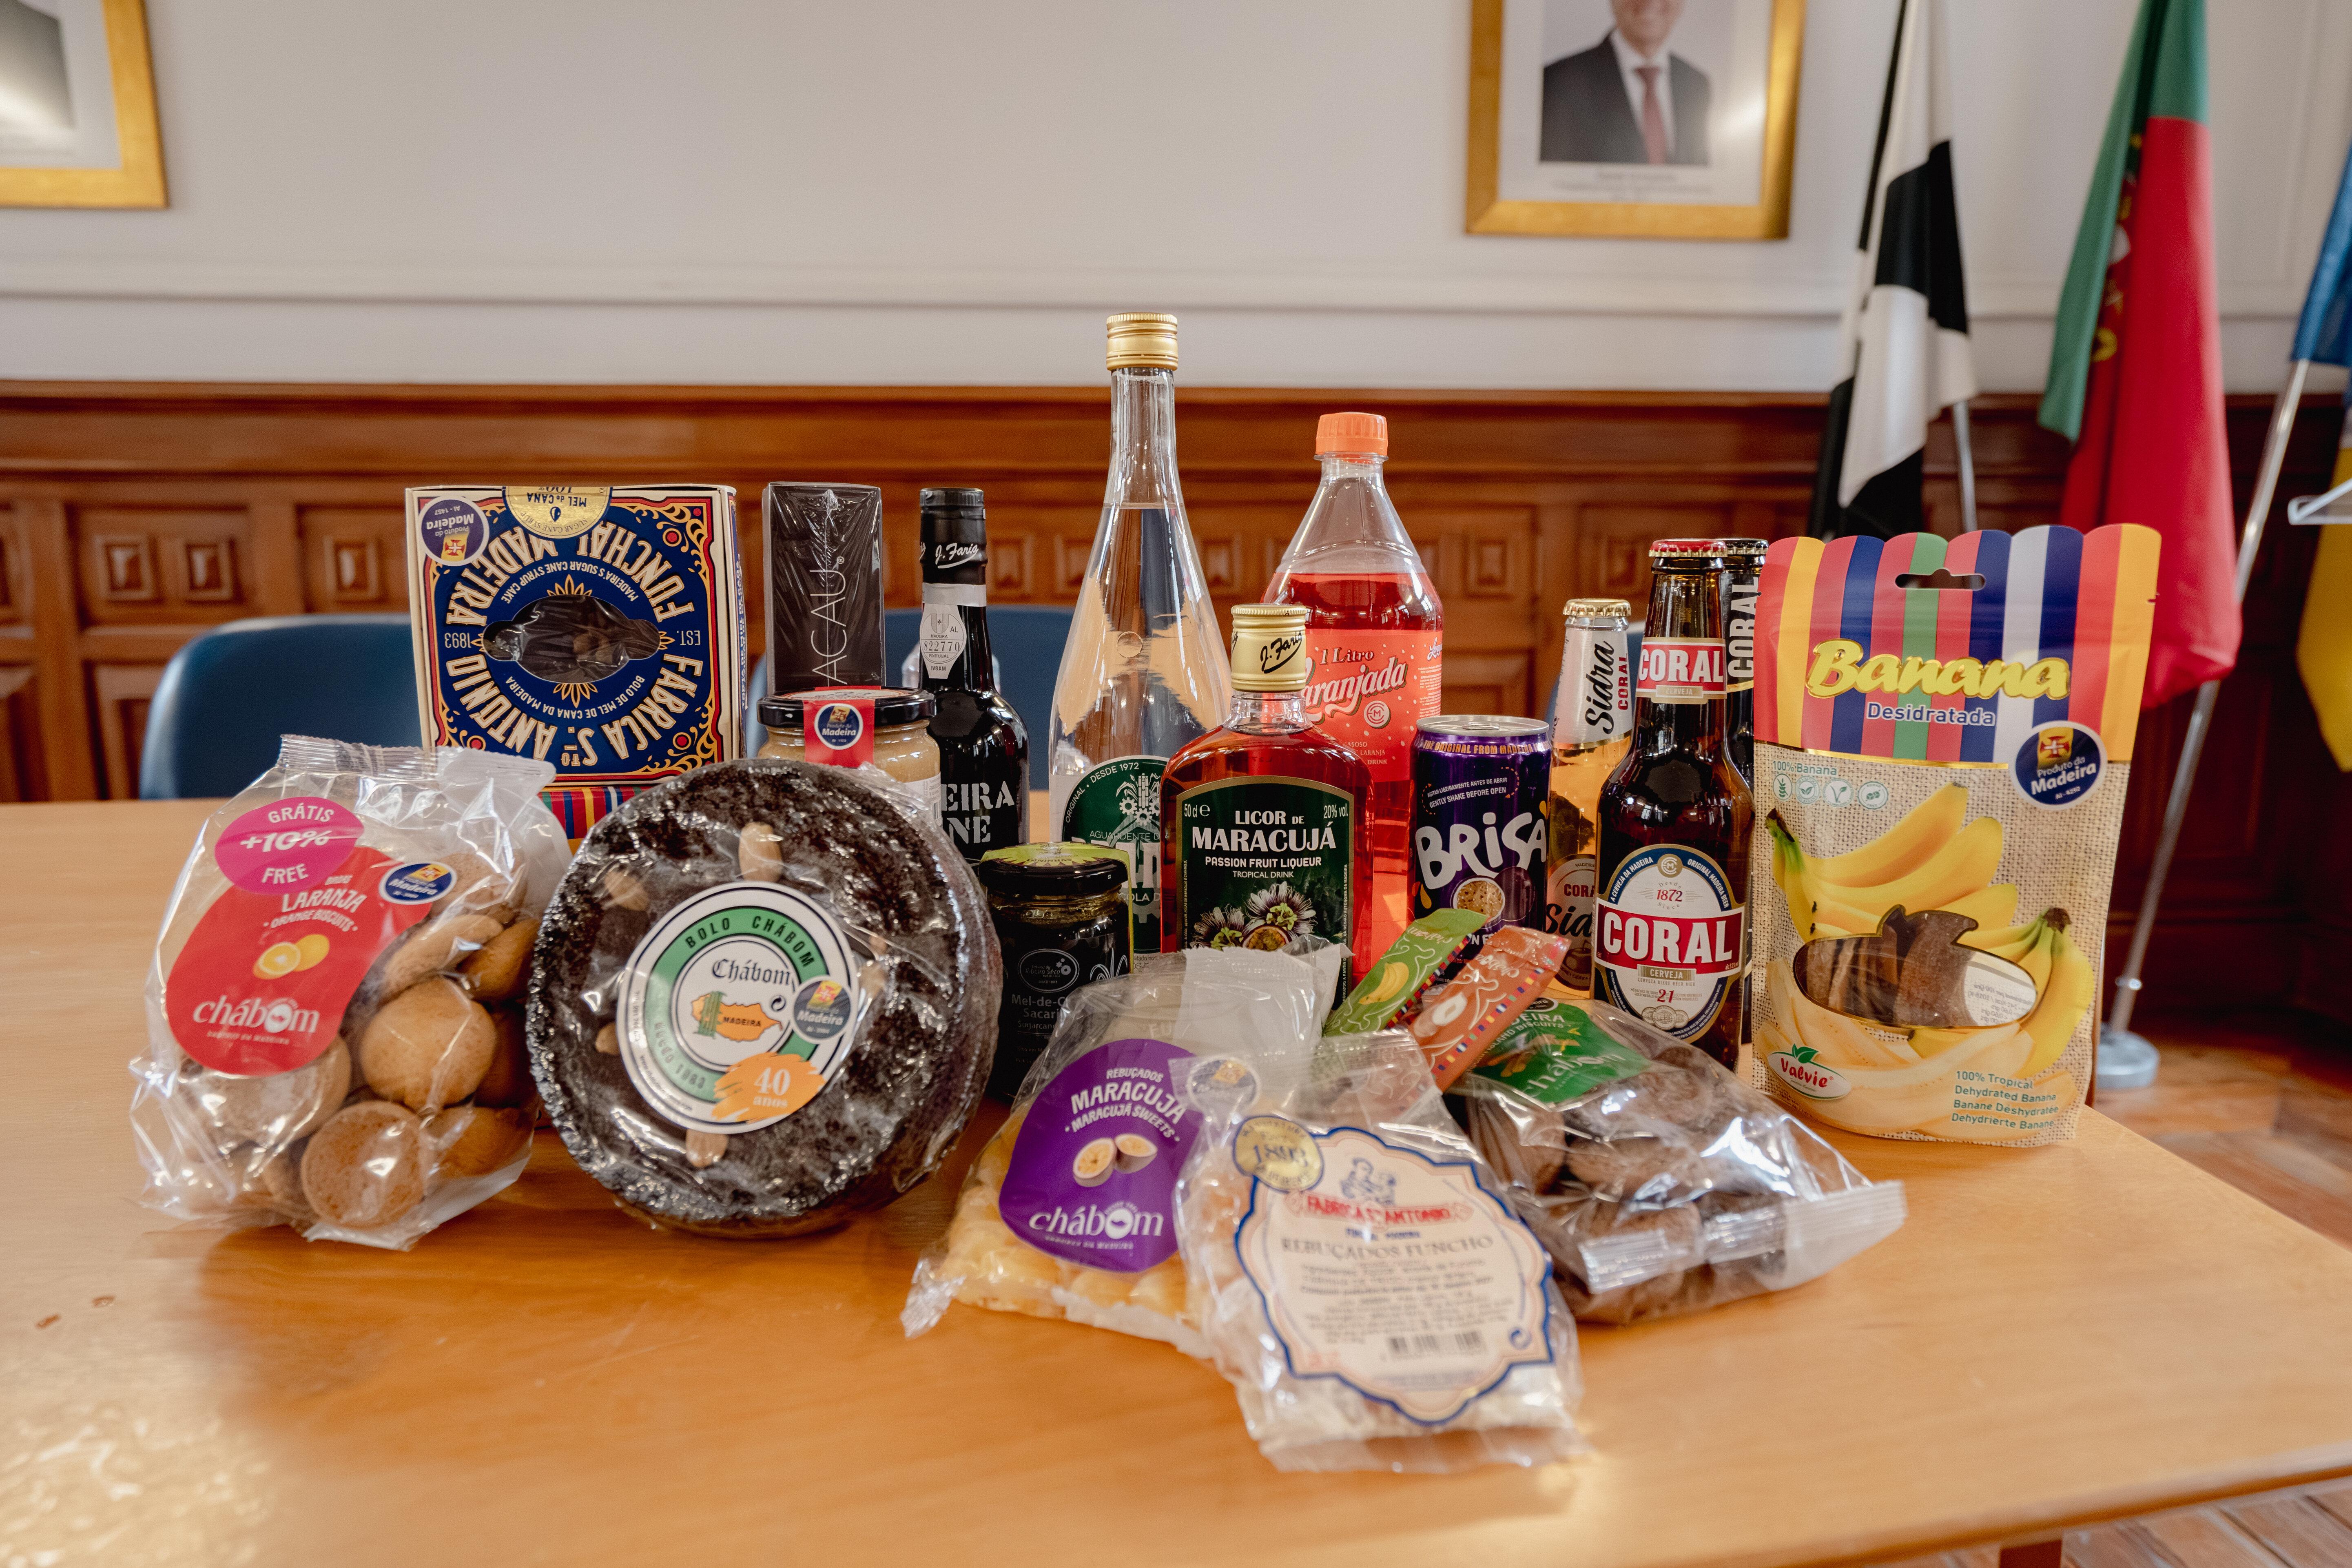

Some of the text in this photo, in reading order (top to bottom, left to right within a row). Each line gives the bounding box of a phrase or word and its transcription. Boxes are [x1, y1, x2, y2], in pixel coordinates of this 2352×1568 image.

[527, 493, 554, 504] CANA
[568, 496, 587, 507] MEL
[426, 514, 474, 530] Madeira
[445, 526, 469, 534] Produto
[520, 512, 587, 533] SUGAR CANE SYRUP
[946, 543, 979, 560] Faria
[446, 526, 558, 625] MADEIRA
[501, 561, 639, 604] MADEIRA'S SUGAR CANE SYRUP CAKE
[1727, 577, 1762, 678] CORAL
[444, 630, 700, 648] EST. 1893
[924, 641, 959, 651] 822770
[1320, 648, 1374, 665] 1 Litro
[1639, 649, 1723, 683] CORAL
[1806, 639, 2071, 700] Banana
[1585, 640, 1615, 734] Sidra
[1617, 655, 1628, 710] CORAL
[446, 653, 557, 761] ANTÓNIO
[505, 675, 645, 719] BOLO DE MEL DE CANA DA MADEIRA
[1867, 702, 1996, 726] Desidratada
[1423, 740, 1434, 749] THE
[1435, 742, 1471, 753] ORIGINAL
[1474, 745, 1497, 754] FROM
[1499, 744, 1534, 754] MADEIRA
[1773, 761, 1837, 775] 100% Banana
[2037, 756, 2085, 778] Produto da
[1440, 782, 1469, 793] LIGEIRAMENTE
[2031, 763, 2096, 795] Madeira
[941, 781, 1017, 812] EIRA
[1066, 762, 1139, 823] ORIGINAL DESDE 1972
[1429, 797, 1446, 808] GENTLY
[1447, 793, 1466, 802] SHAKE
[1466, 789, 1489, 798] BEFORE
[268, 802, 334, 823] GRÁTIS
[1184, 804, 1197, 817] 50 cl
[1235, 811, 1304, 825] LICOR DE
[1324, 802, 1348, 819] 20% vol.
[240, 831, 332, 852] +10%
[1090, 831, 1150, 840] AGUARDENTE
[1192, 821, 1336, 852] MARACUJÁ
[1205, 856, 1321, 869] PASSION FRUIT LIQUEUR
[261, 863, 308, 884] FREE
[1612, 876, 1626, 897] CERVEJA
[1630, 857, 1654, 873] MADEIRA
[1687, 859, 1729, 908] ORIGINAL MADEIRA BEER
[388, 878, 438, 895] Madeira
[1657, 889, 1683, 902] 1872
[281, 888, 368, 914] LARANJA
[270, 908, 354, 932] ORANGE BISCUITS
[1546, 903, 1592, 937] Sid
[685, 916, 814, 968] BOLO CHÁBOM
[1603, 911, 1733, 964] CORAL
[712, 959, 791, 987] Chábom
[1650, 969, 1683, 979] CERVEJA
[1012, 994, 1065, 1007] Mel-de-C
[1657, 989, 1674, 1003] 21
[192, 994, 320, 1033] chábom
[723, 1016, 761, 1027] MADEIRA
[797, 1010, 844, 1025] Madeira
[1517, 1021, 1564, 1032] BISCUITS
[753, 1068, 791, 1096] 40
[1106, 1067, 1164, 1083] REBUÇADOS
[1781, 1058, 1827, 1087] Valvie
[1957, 1071, 2033, 1089] 100% Tropical
[753, 1095, 788, 1108] anos
[1955, 1085, 2018, 1101] Dehydrated
[1953, 1100, 1992, 1110] Banane
[1071, 1103, 1176, 1139] MARACUJÁ SWEETS
[1952, 1113, 2054, 1129] Dehydrierte Banane
[1028, 1204, 1165, 1240] chábom
[1281, 1236, 1493, 1260] REBUÇADOS FUNCHO
